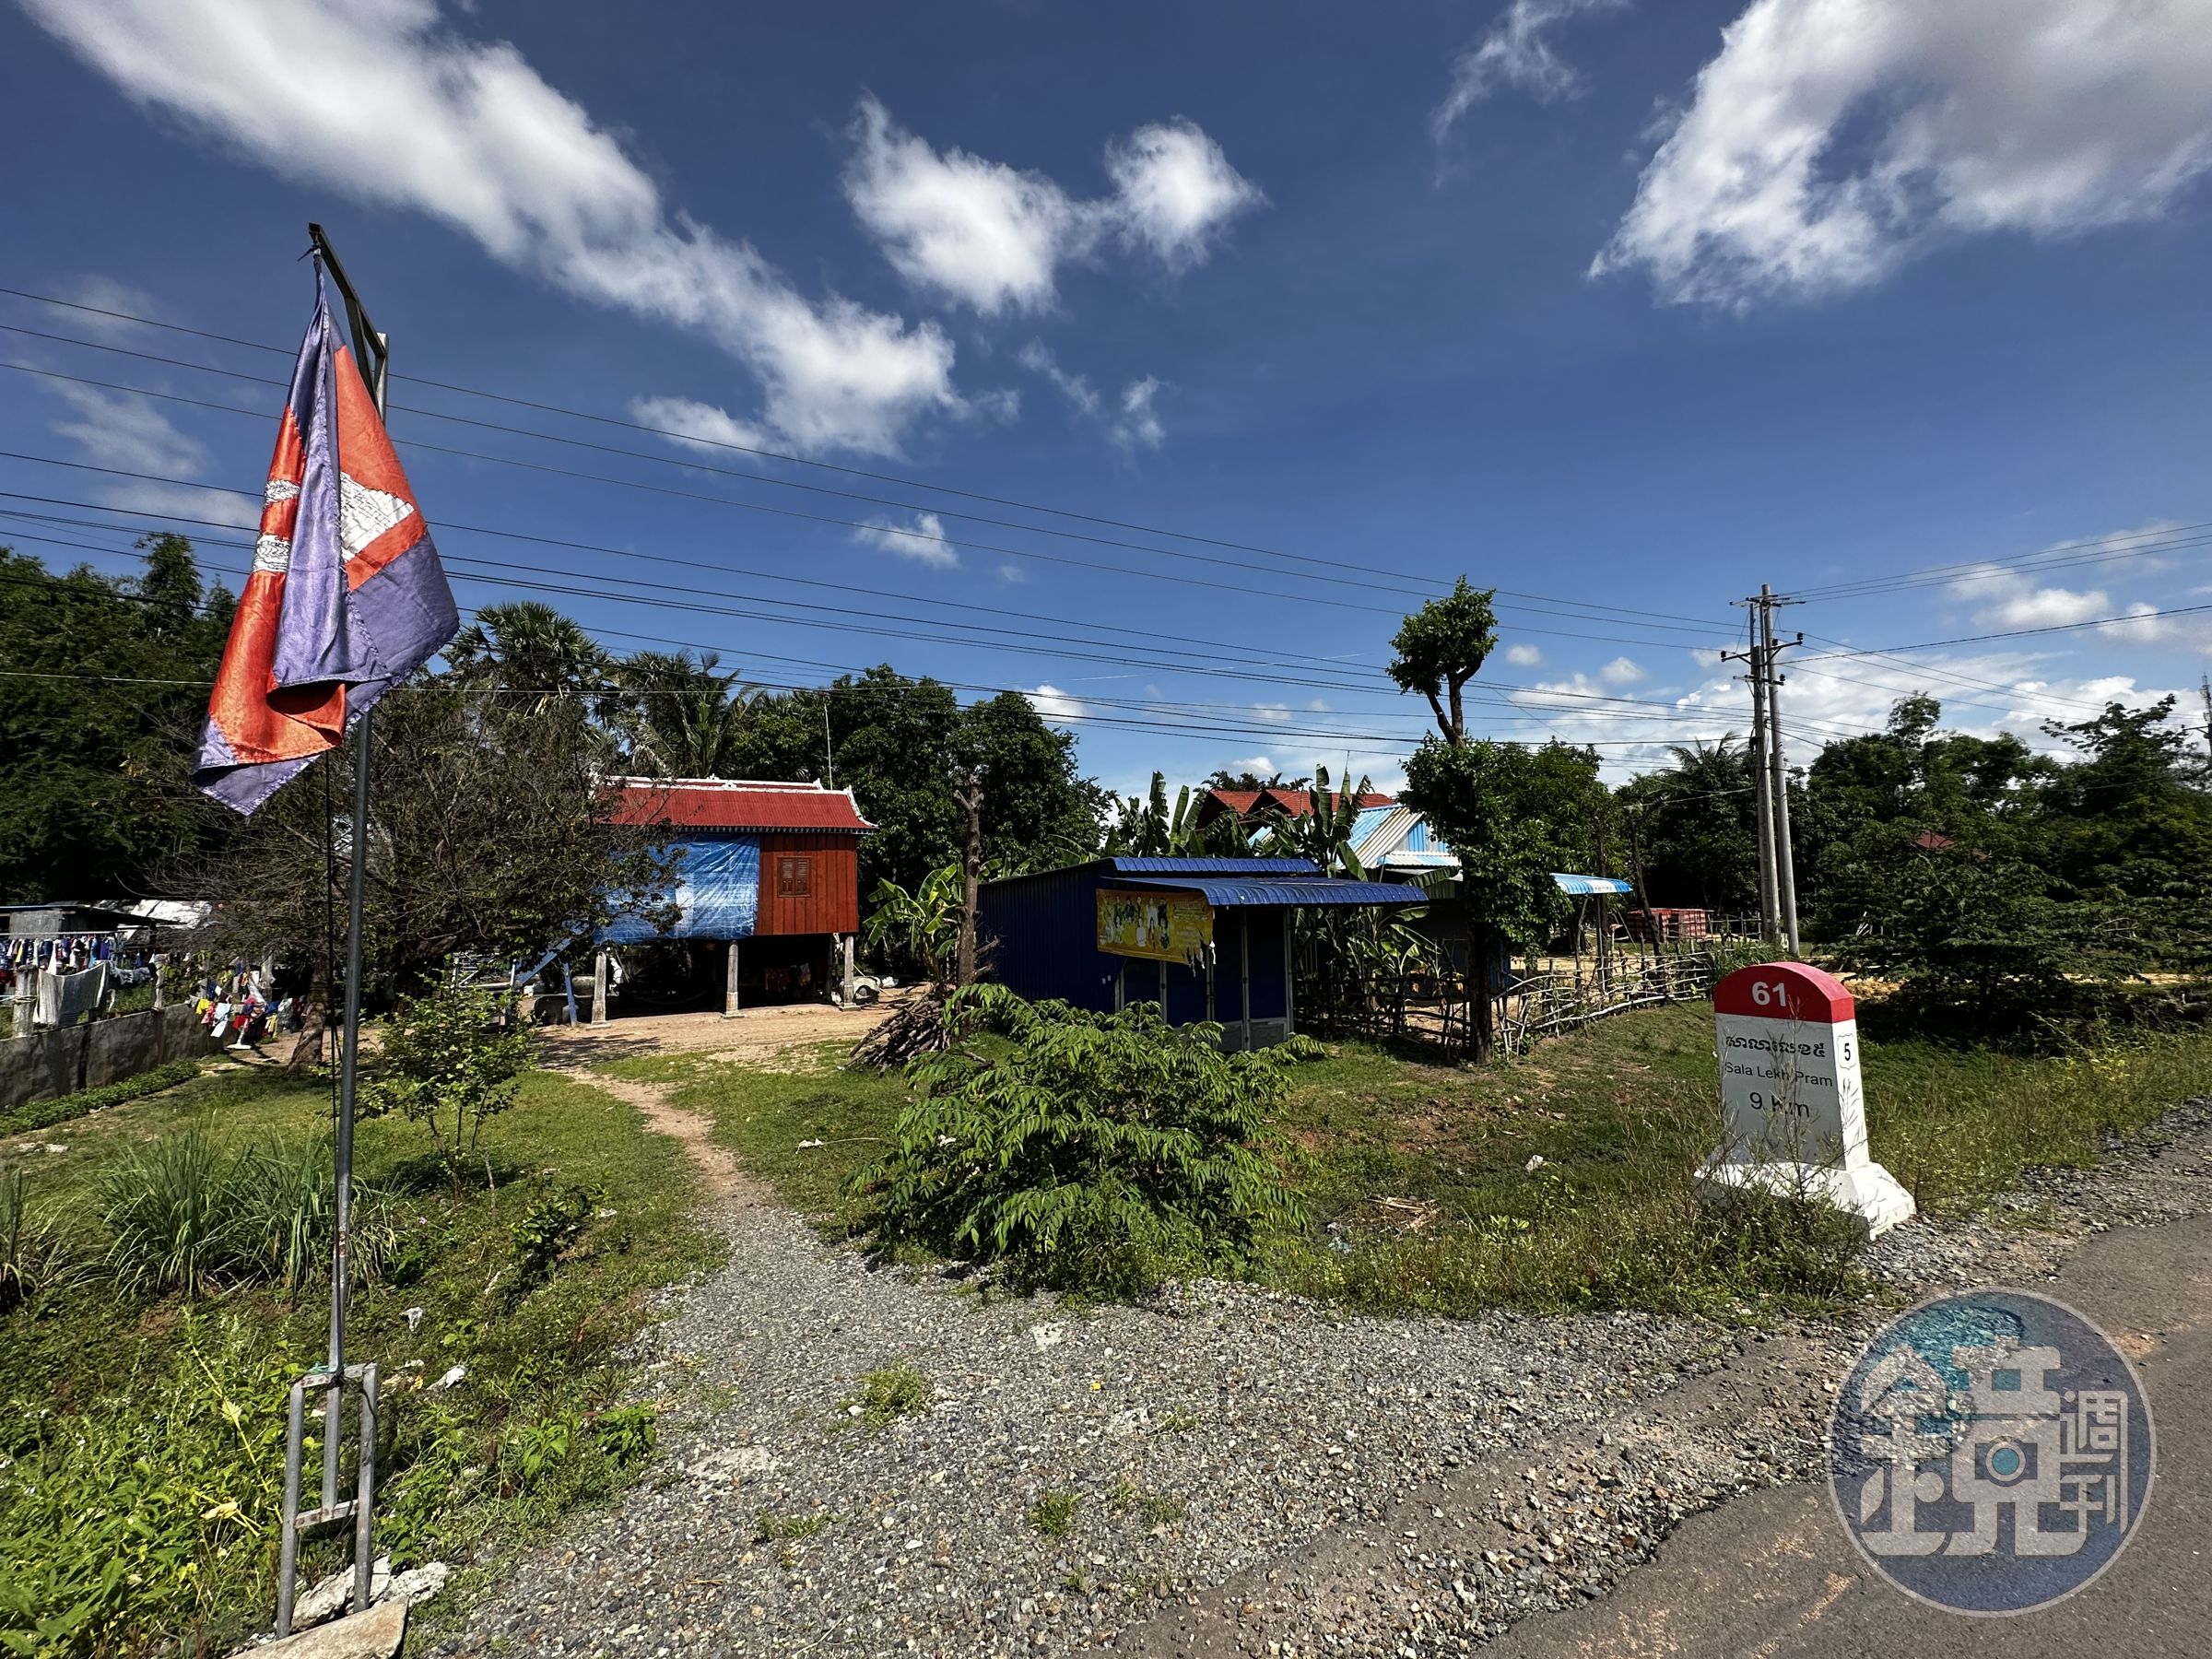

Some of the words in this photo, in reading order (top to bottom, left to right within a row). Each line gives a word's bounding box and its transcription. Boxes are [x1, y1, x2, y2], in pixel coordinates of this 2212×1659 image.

[1751, 981, 1786, 1006] 61
[1844, 1042, 1851, 1061] 5
[1724, 1062, 1753, 1076] Sala
[1795, 1070, 1832, 1087] Pram
[1749, 1092, 1762, 1110] 9
